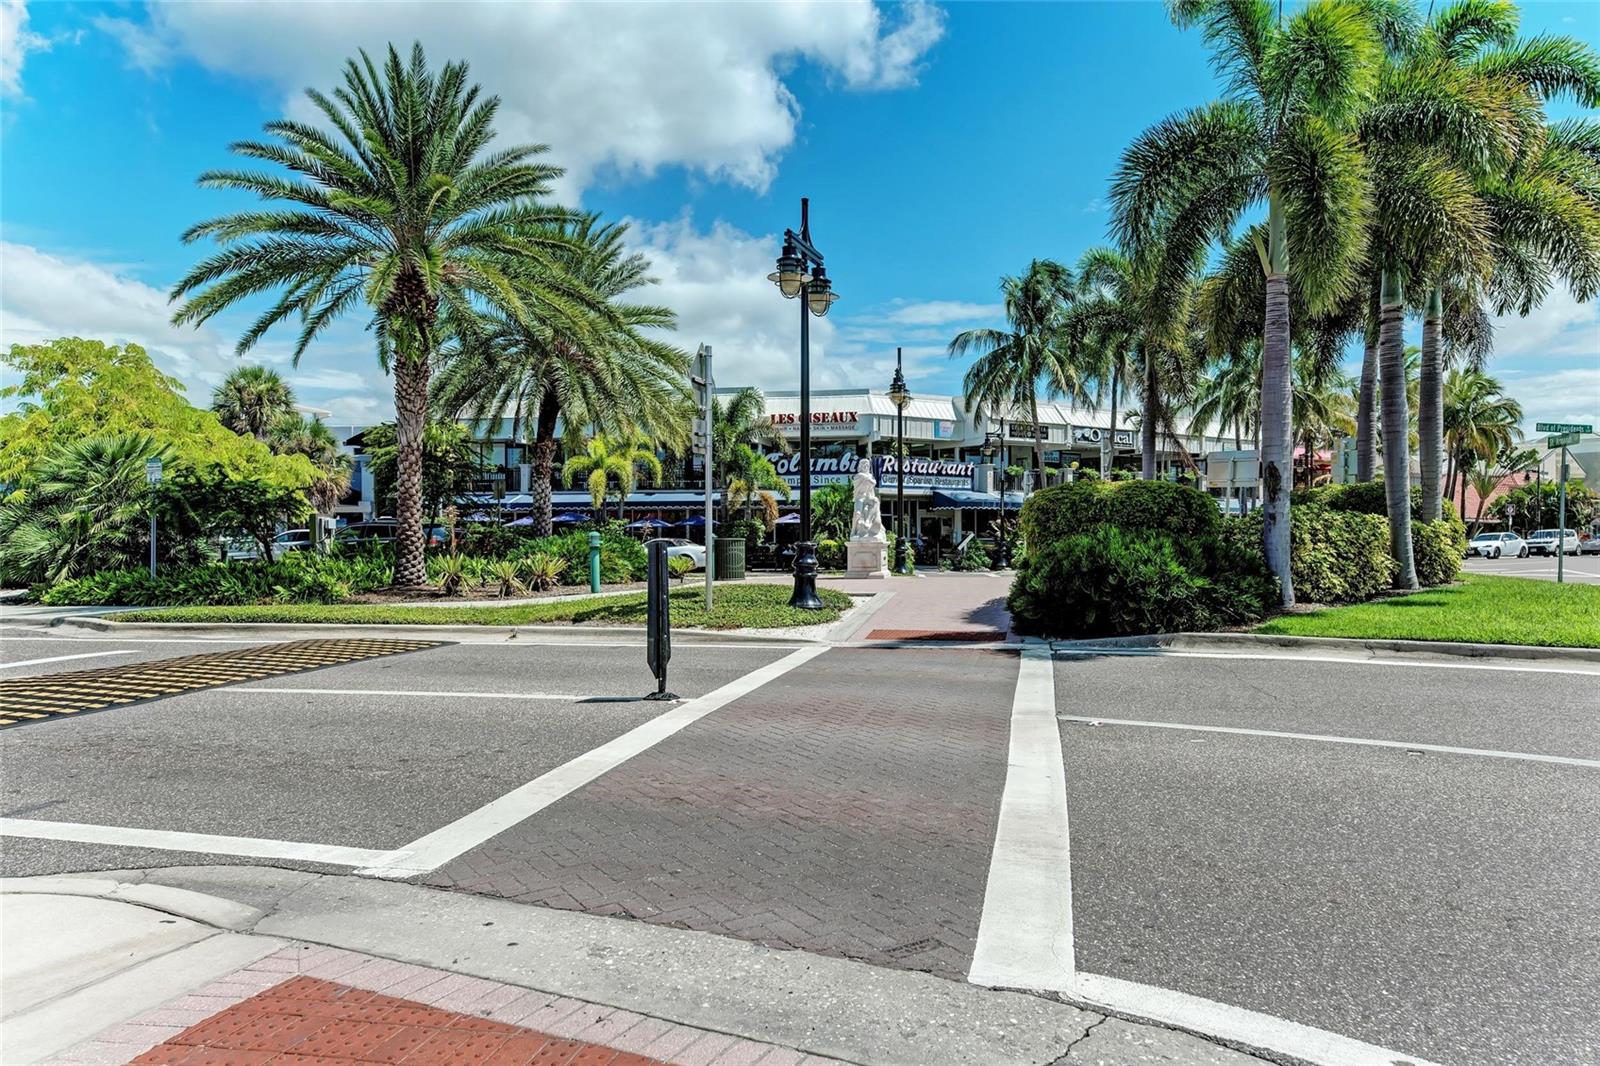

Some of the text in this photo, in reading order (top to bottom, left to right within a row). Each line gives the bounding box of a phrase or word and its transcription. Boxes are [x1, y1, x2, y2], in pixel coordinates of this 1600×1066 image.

[770, 411, 858, 424] LES ISEAUX
[1090, 428, 1133, 444] Oical
[813, 475, 841, 484] Since
